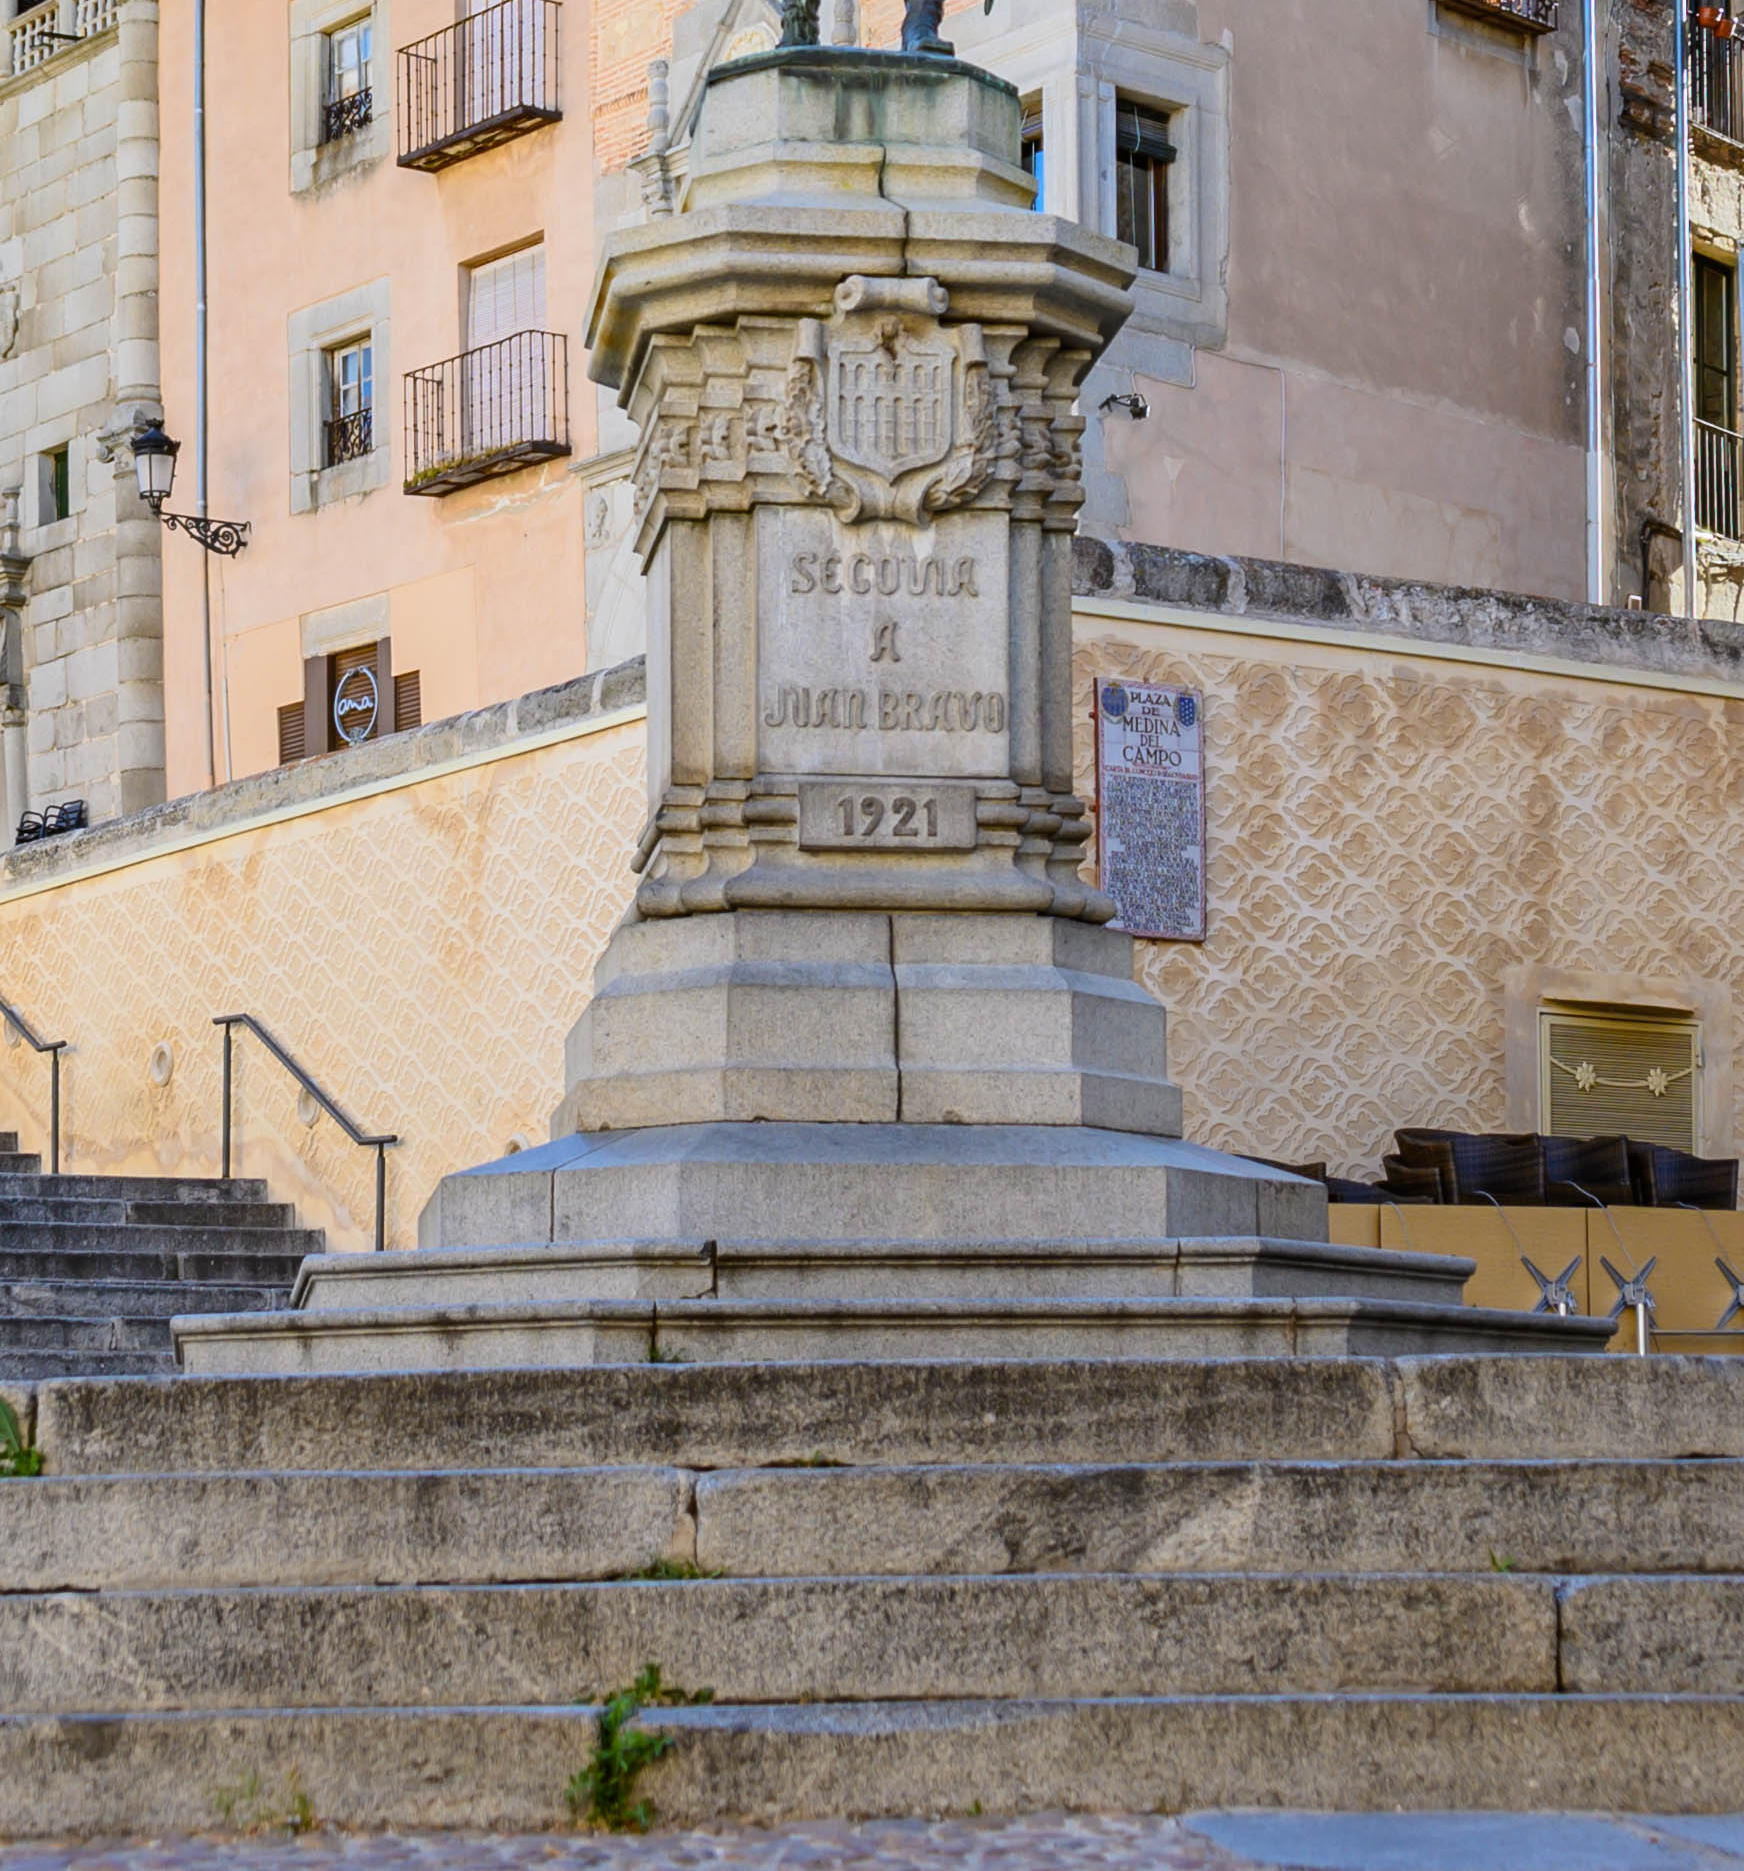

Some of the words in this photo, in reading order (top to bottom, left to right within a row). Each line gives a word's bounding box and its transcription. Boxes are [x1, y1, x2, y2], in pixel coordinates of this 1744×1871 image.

[791, 551, 979, 598] SEGOVIA
[869, 621, 901, 662] A
[763, 687, 867, 730] JUAN
[877, 688, 1005, 734] BRAVO
[1129, 691, 1172, 707] PLAZA
[1141, 706, 1160, 717] DE
[1122, 715, 1182, 738] MEDINA
[1139, 733, 1162, 749] DEL
[1122, 745, 1182, 767] CAMPO
[837, 794, 938, 838] 1921
